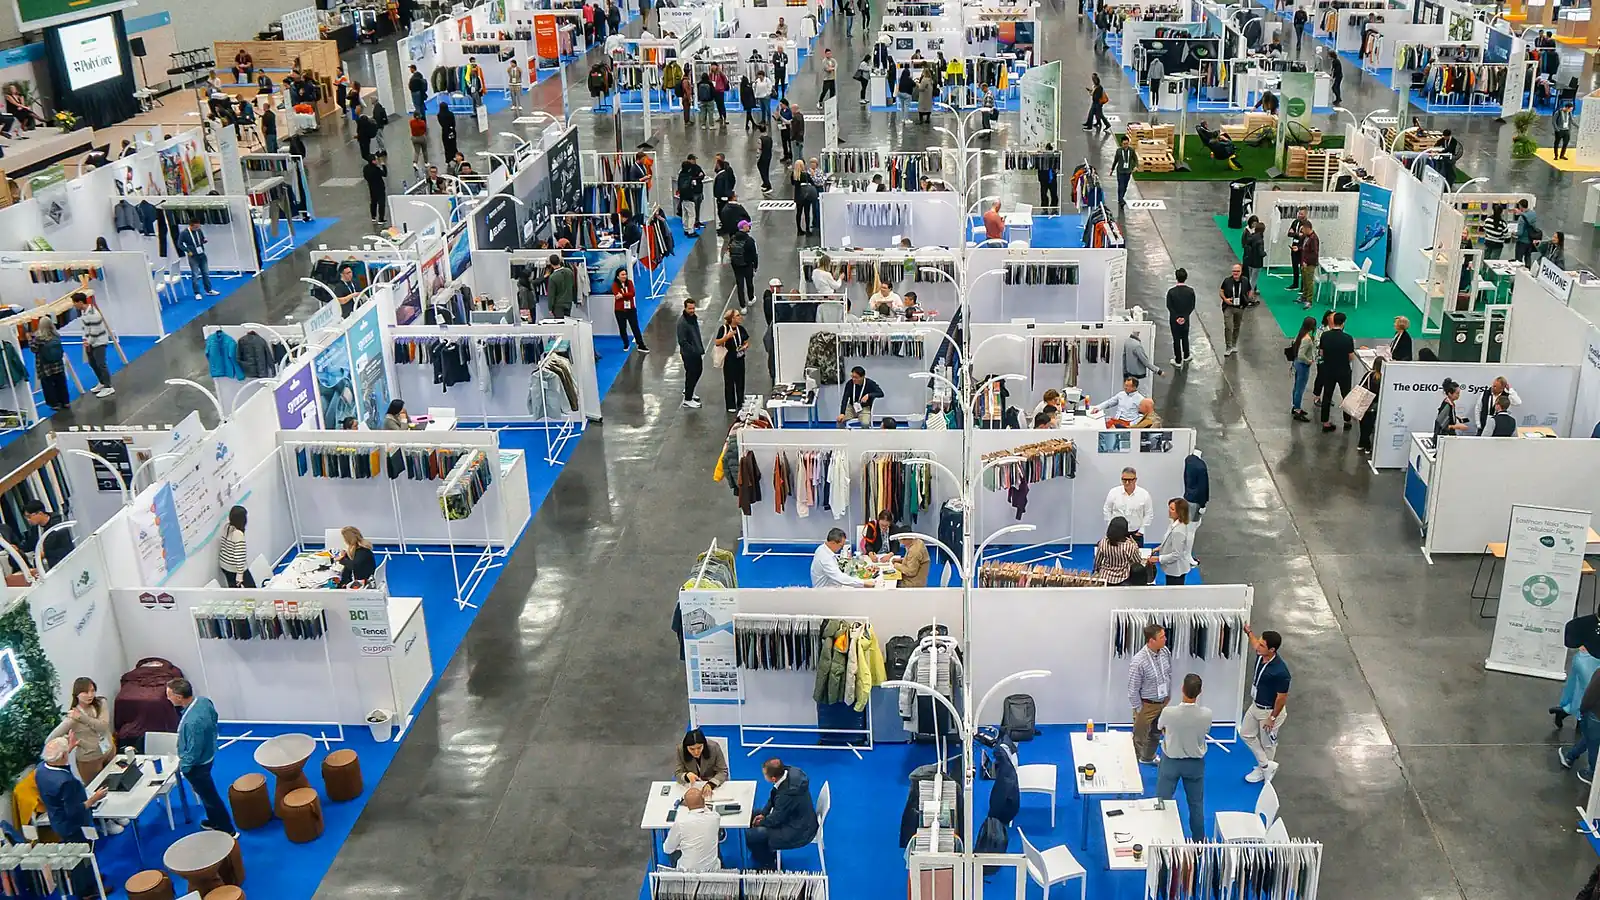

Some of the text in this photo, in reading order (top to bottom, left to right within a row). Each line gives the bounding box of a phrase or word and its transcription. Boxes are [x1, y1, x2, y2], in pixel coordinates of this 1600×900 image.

[1542, 264, 1569, 291] PANTONE
[1393, 383, 1411, 392] The
[1468, 384, 1491, 394] Syst
[1516, 517, 1543, 525] Eastman
[349, 610, 369, 621] BCI
